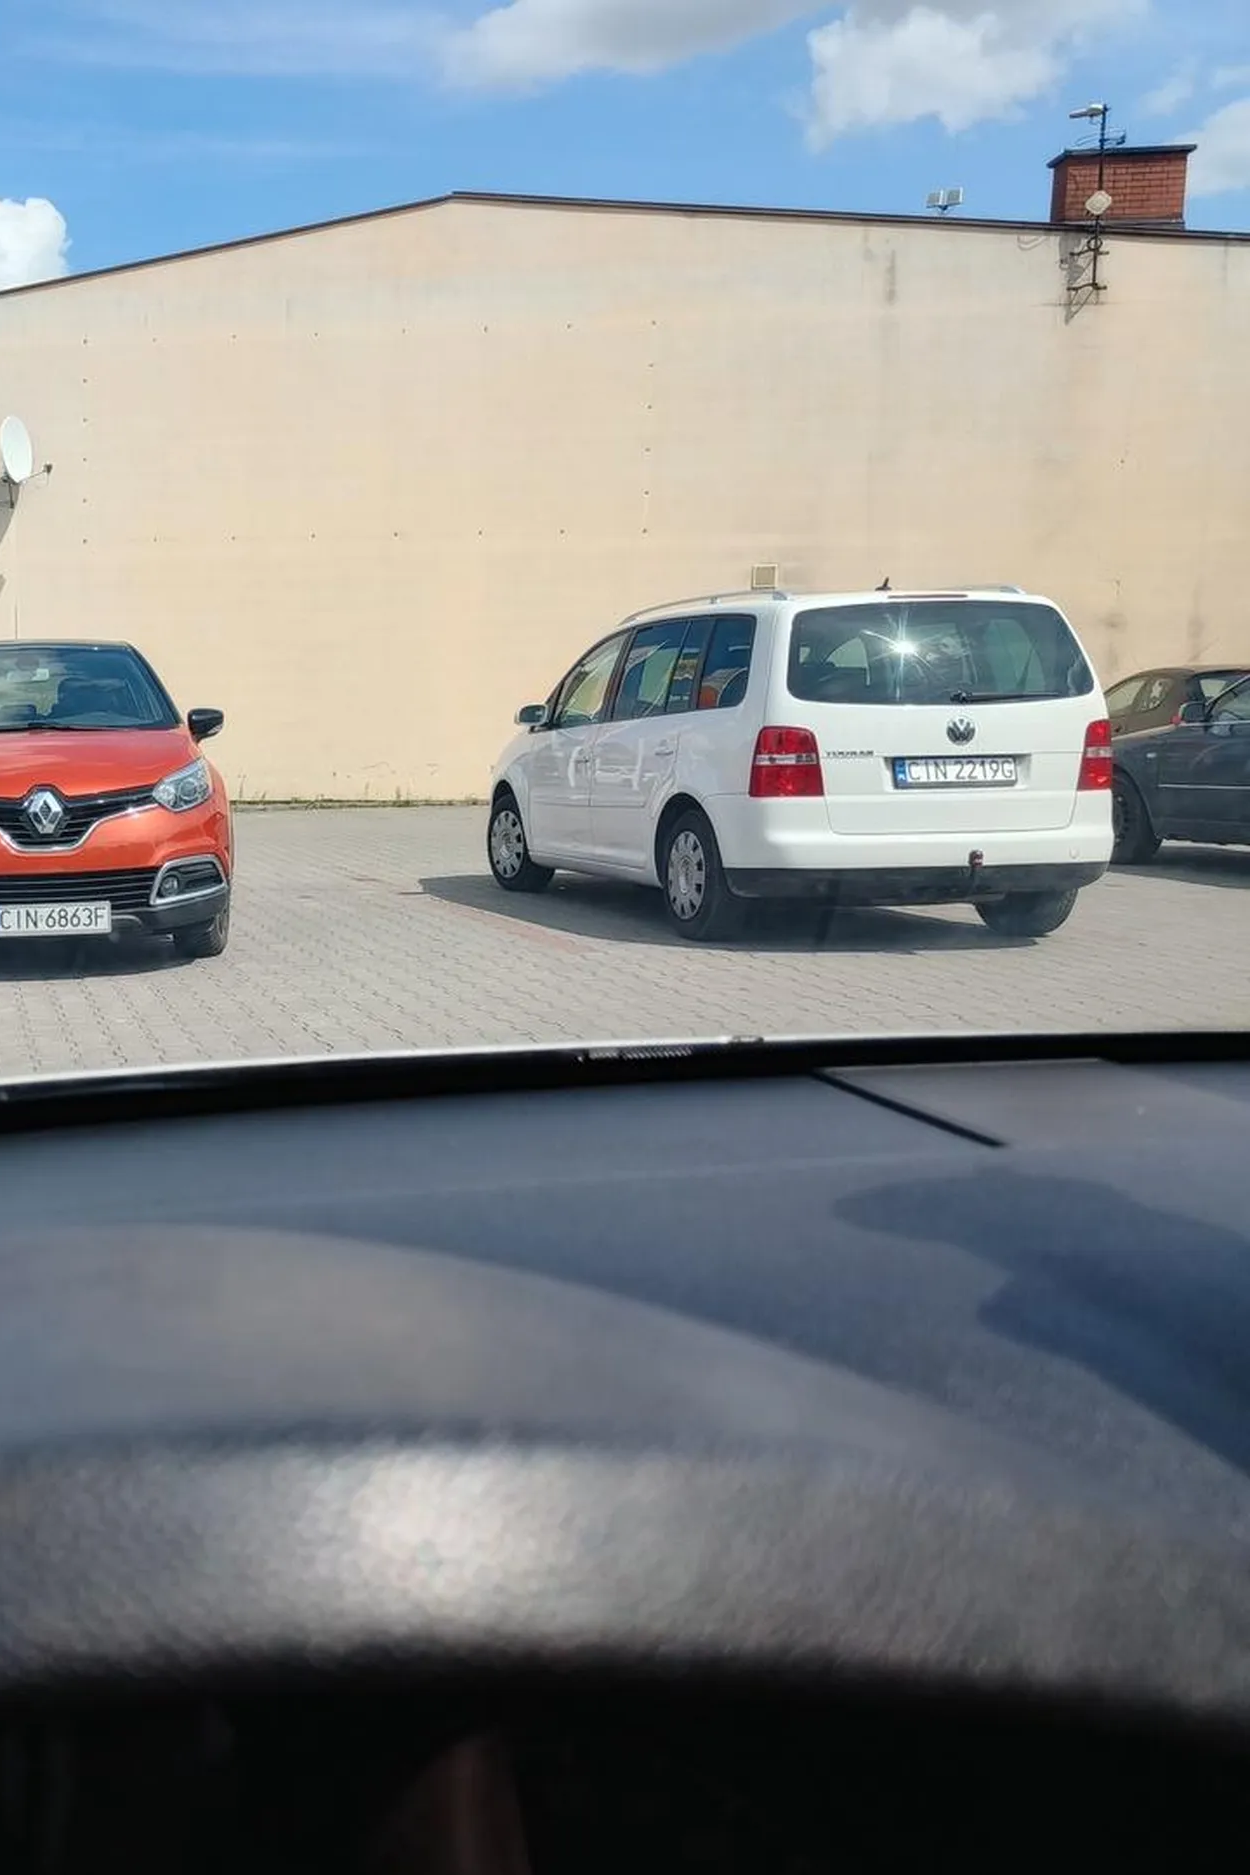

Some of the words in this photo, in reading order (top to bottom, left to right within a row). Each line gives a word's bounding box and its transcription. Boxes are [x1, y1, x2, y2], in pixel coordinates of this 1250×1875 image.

[907, 760, 948, 781] CIN
[954, 760, 1013, 781] 2219G
[0, 909, 38, 930] CIN
[45, 907, 106, 928] 6863F
